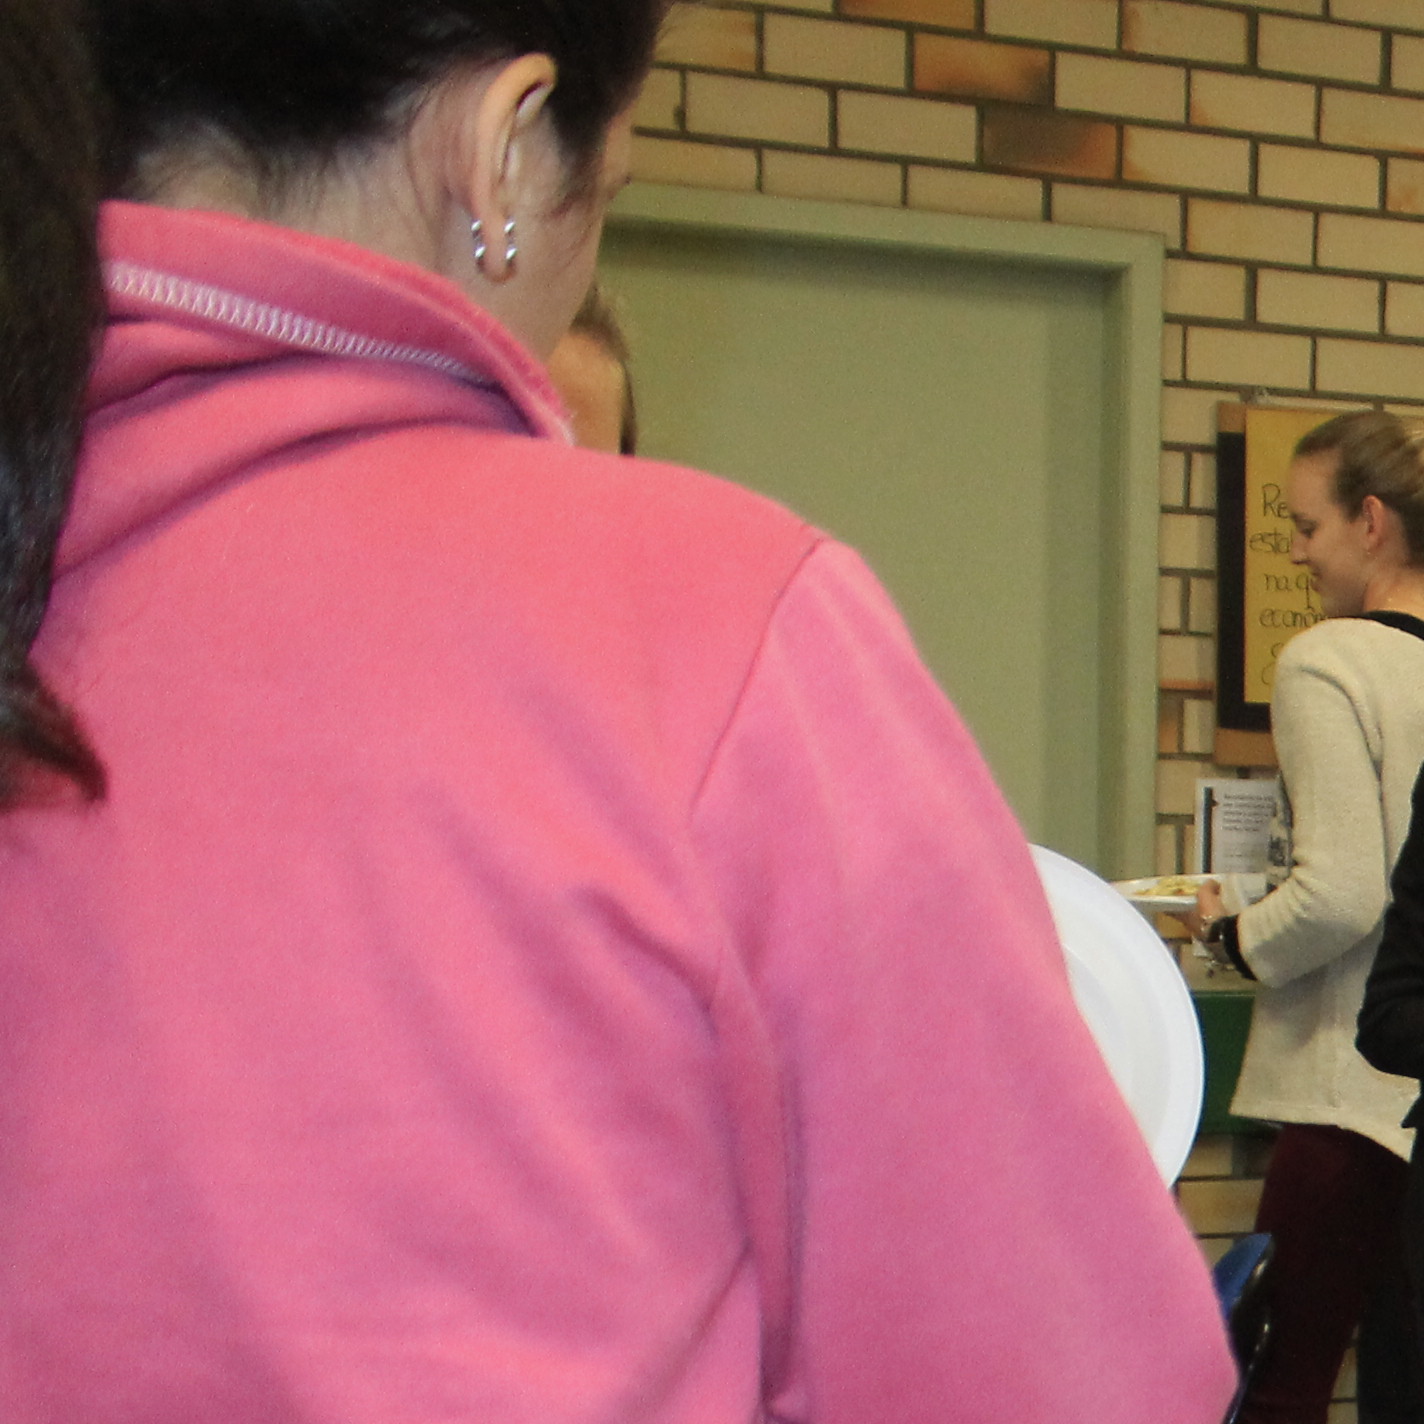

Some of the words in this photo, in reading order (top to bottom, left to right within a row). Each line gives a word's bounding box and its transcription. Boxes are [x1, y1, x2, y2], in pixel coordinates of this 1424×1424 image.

[1261, 483, 1290, 519] Re
[1248, 531, 1293, 555] esta
[1295, 570, 1316, 609] q
